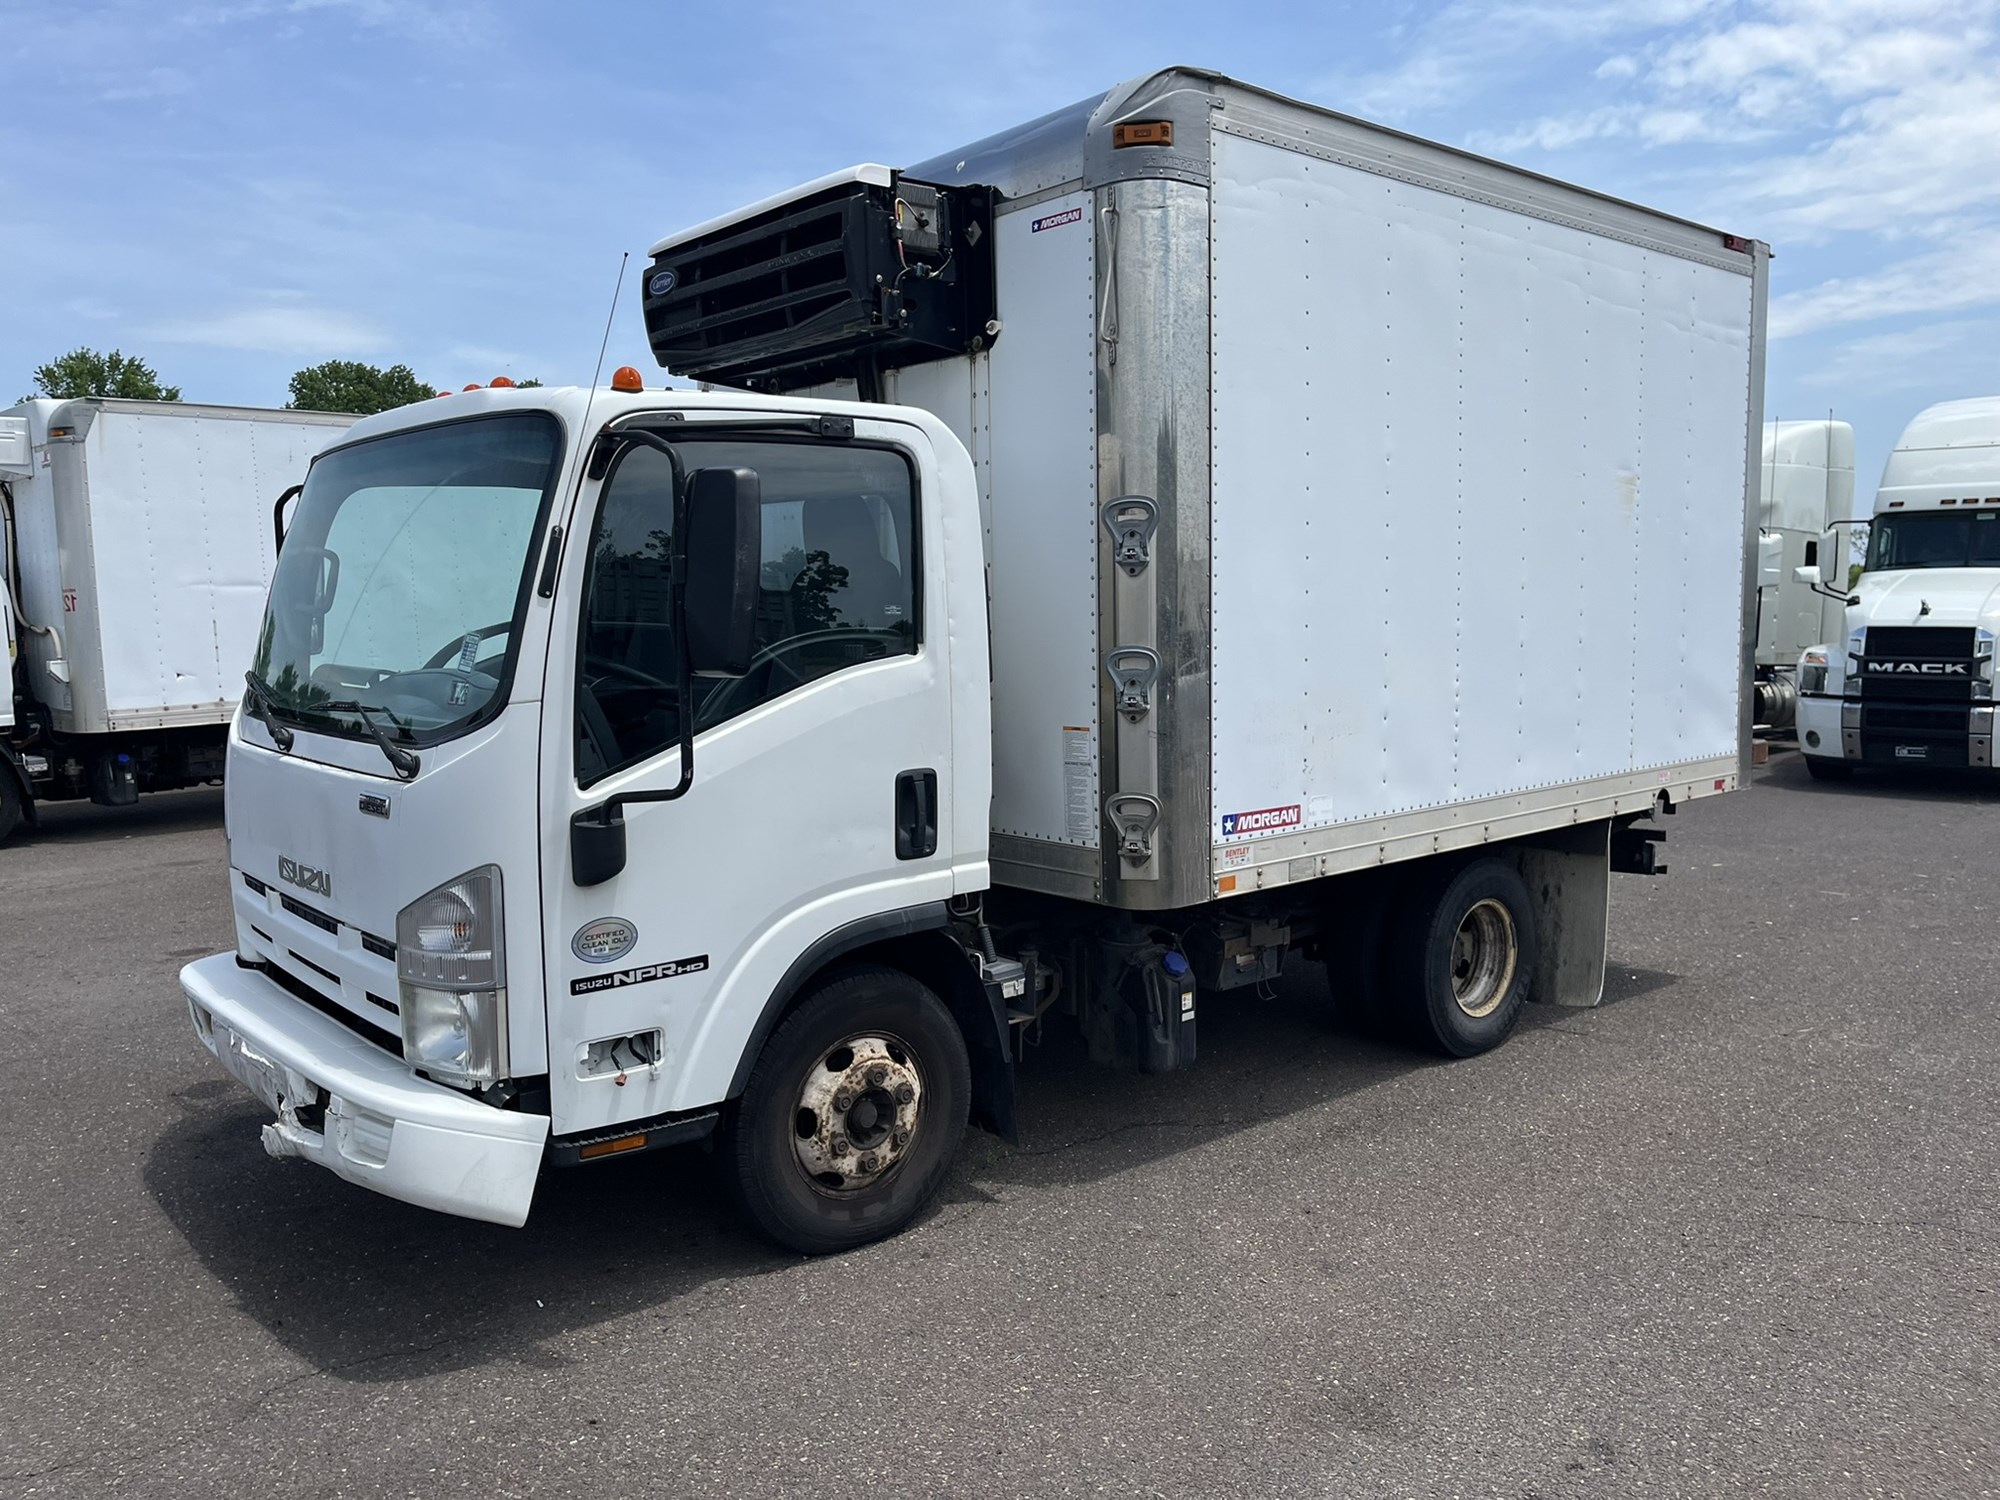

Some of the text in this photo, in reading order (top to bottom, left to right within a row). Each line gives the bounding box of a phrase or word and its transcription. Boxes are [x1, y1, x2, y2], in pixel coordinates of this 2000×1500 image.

[1040, 210, 1080, 229] MORGAN
[1868, 662, 1968, 674] MACK
[1236, 807, 1299, 831] MORGAN
[1225, 846, 1250, 858] BENTLEY
[278, 854, 331, 898] ISUZU
[581, 940, 609, 950] CLEAN
[612, 936, 628, 944] IDLE
[585, 929, 625, 942] CERTIFIED
[575, 977, 612, 991] ISUZU
[613, 962, 677, 987] NPR
